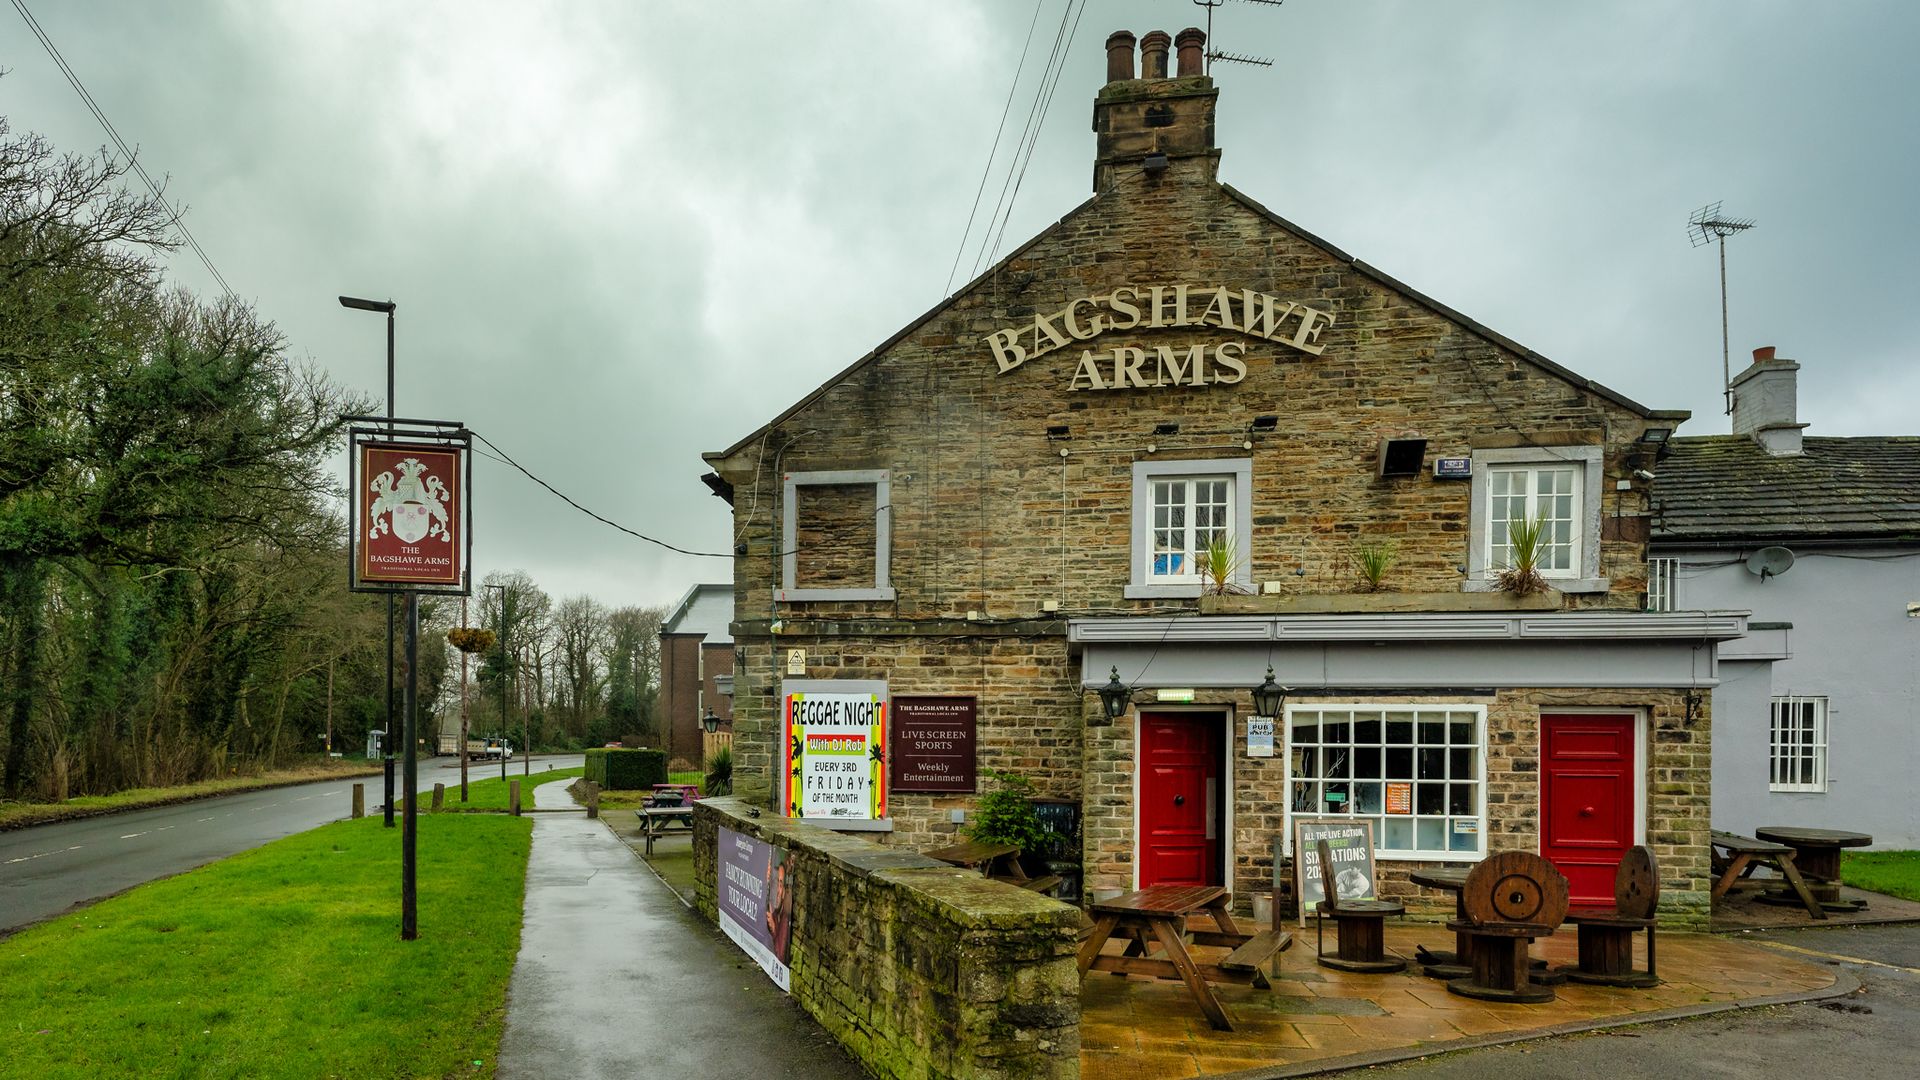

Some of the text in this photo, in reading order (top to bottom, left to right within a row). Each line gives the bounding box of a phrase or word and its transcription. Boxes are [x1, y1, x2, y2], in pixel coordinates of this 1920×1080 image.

[982, 284, 1336, 375] BAGSHAWE
[1066, 342, 1247, 391] ARMS
[370, 555, 422, 564] BAGSHAWE
[792, 701, 882, 726] REGGAE NIGHT
[810, 739, 862, 751] With DJ Rob
[915, 742, 952, 750] SPORTS
[815, 762, 857, 772] EVERY 3RD
[918, 763, 949, 773] Weekly
[808, 776, 864, 790] FRIDAY
[904, 773, 964, 782] Entertainment
[812, 794, 858, 803] OF THE MONTH
[1316, 831, 1327, 839] THE
[1328, 830, 1341, 838] LIVE
[1342, 828, 1364, 837] ACTION,
[1306, 848, 1366, 864] SIX ATIONS
[726, 862, 740, 884] FANCY
